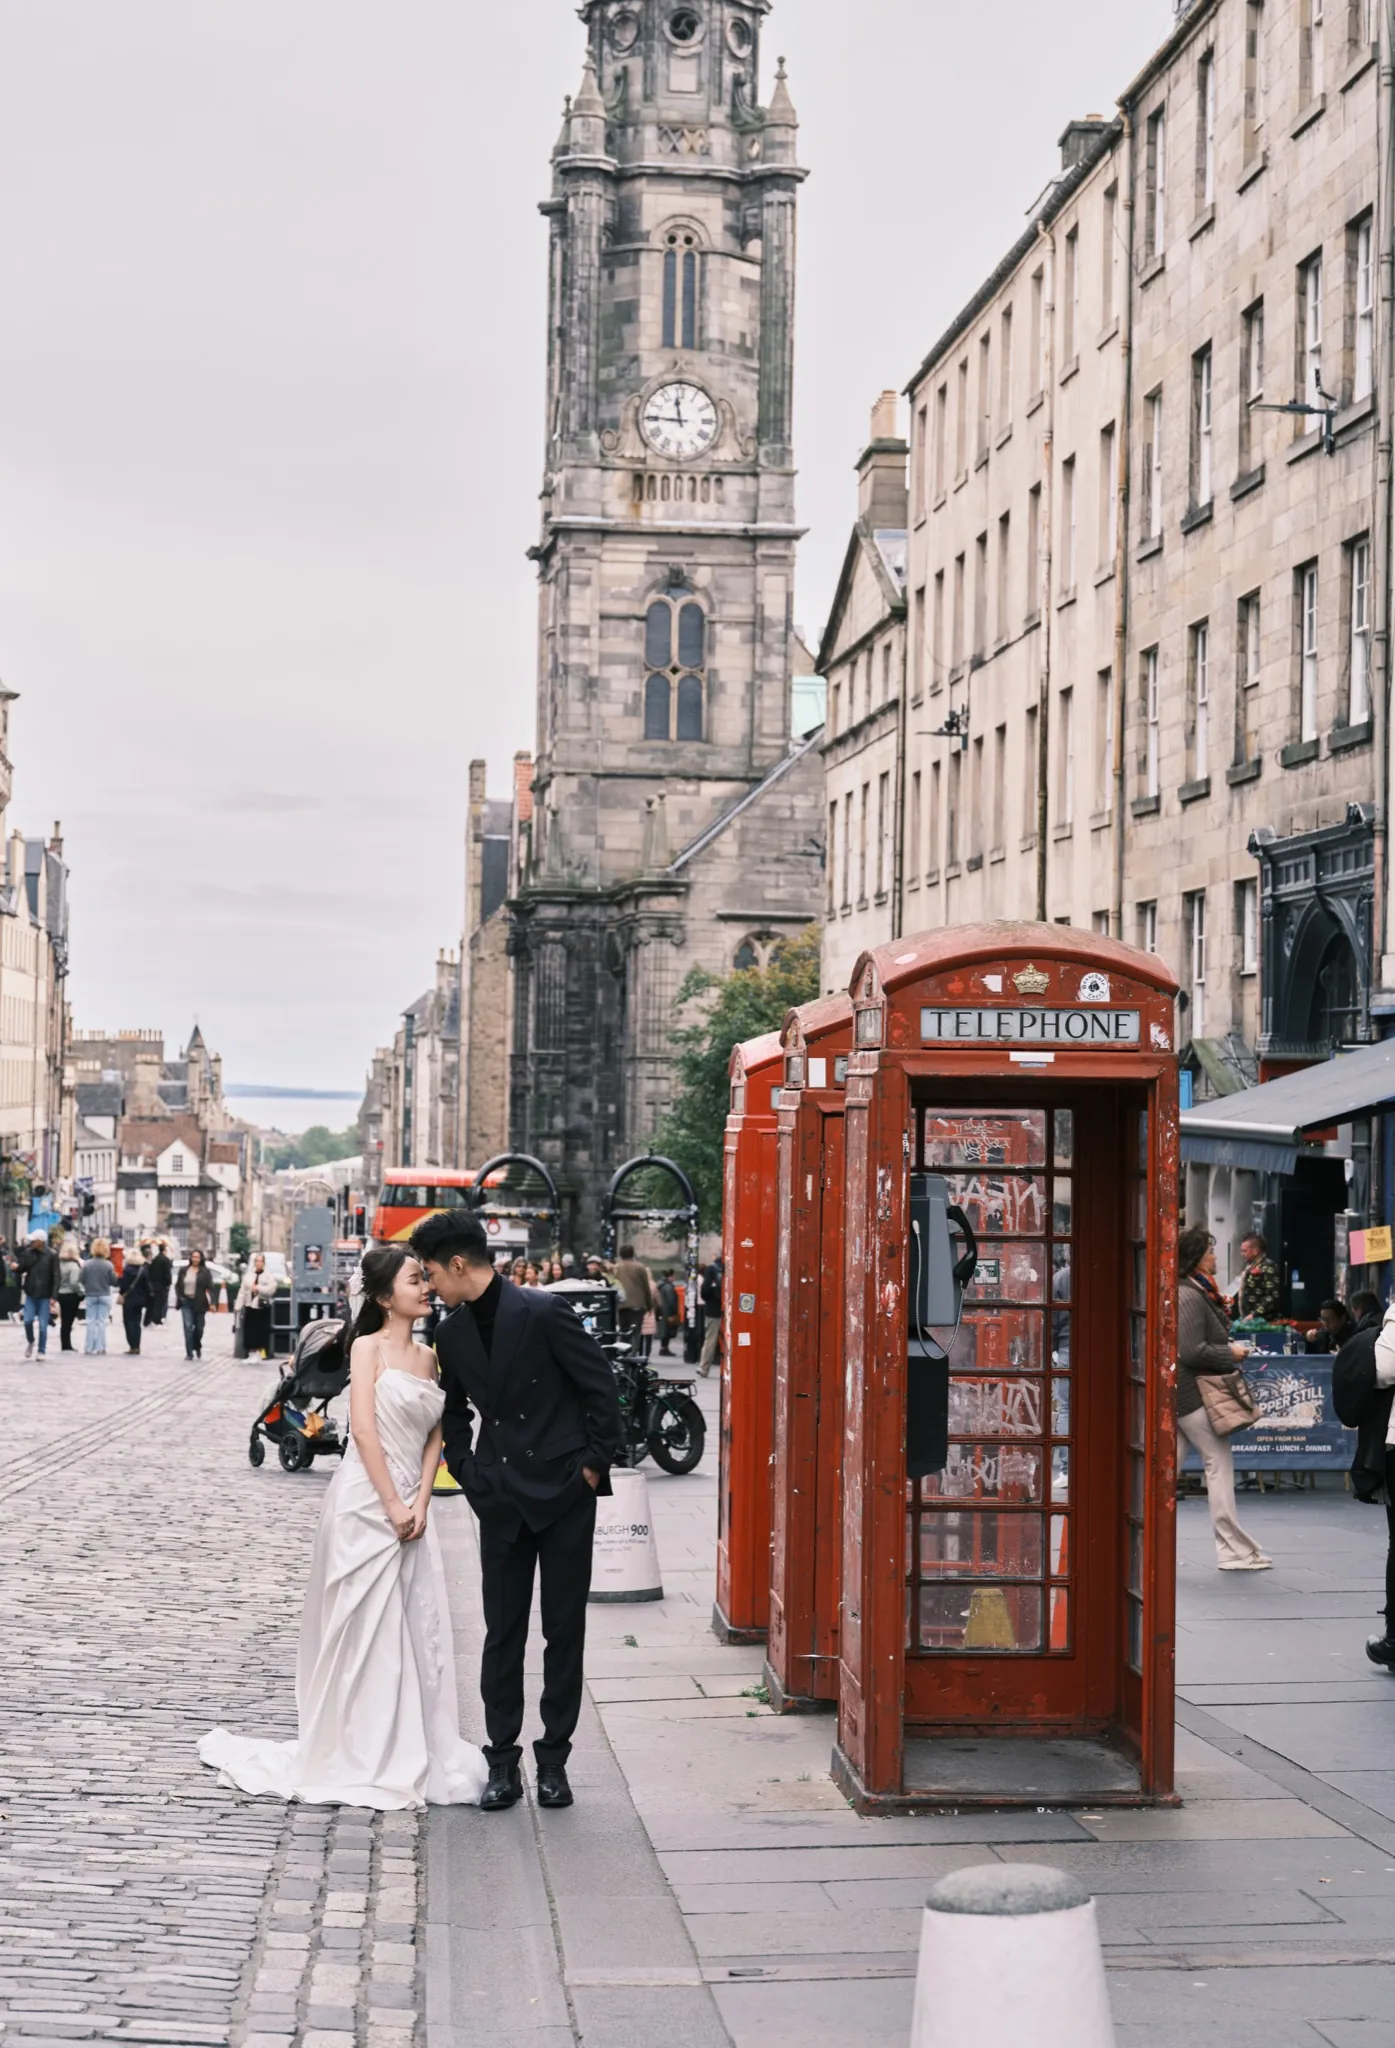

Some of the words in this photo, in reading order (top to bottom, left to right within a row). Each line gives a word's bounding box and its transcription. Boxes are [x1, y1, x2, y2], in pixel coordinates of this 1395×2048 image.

[930, 1010, 1131, 1039] TELEPHONE
[1259, 1395, 1291, 1413] PPER
[1293, 1386, 1325, 1404] STILL
[630, 1524, 648, 1536] 900
